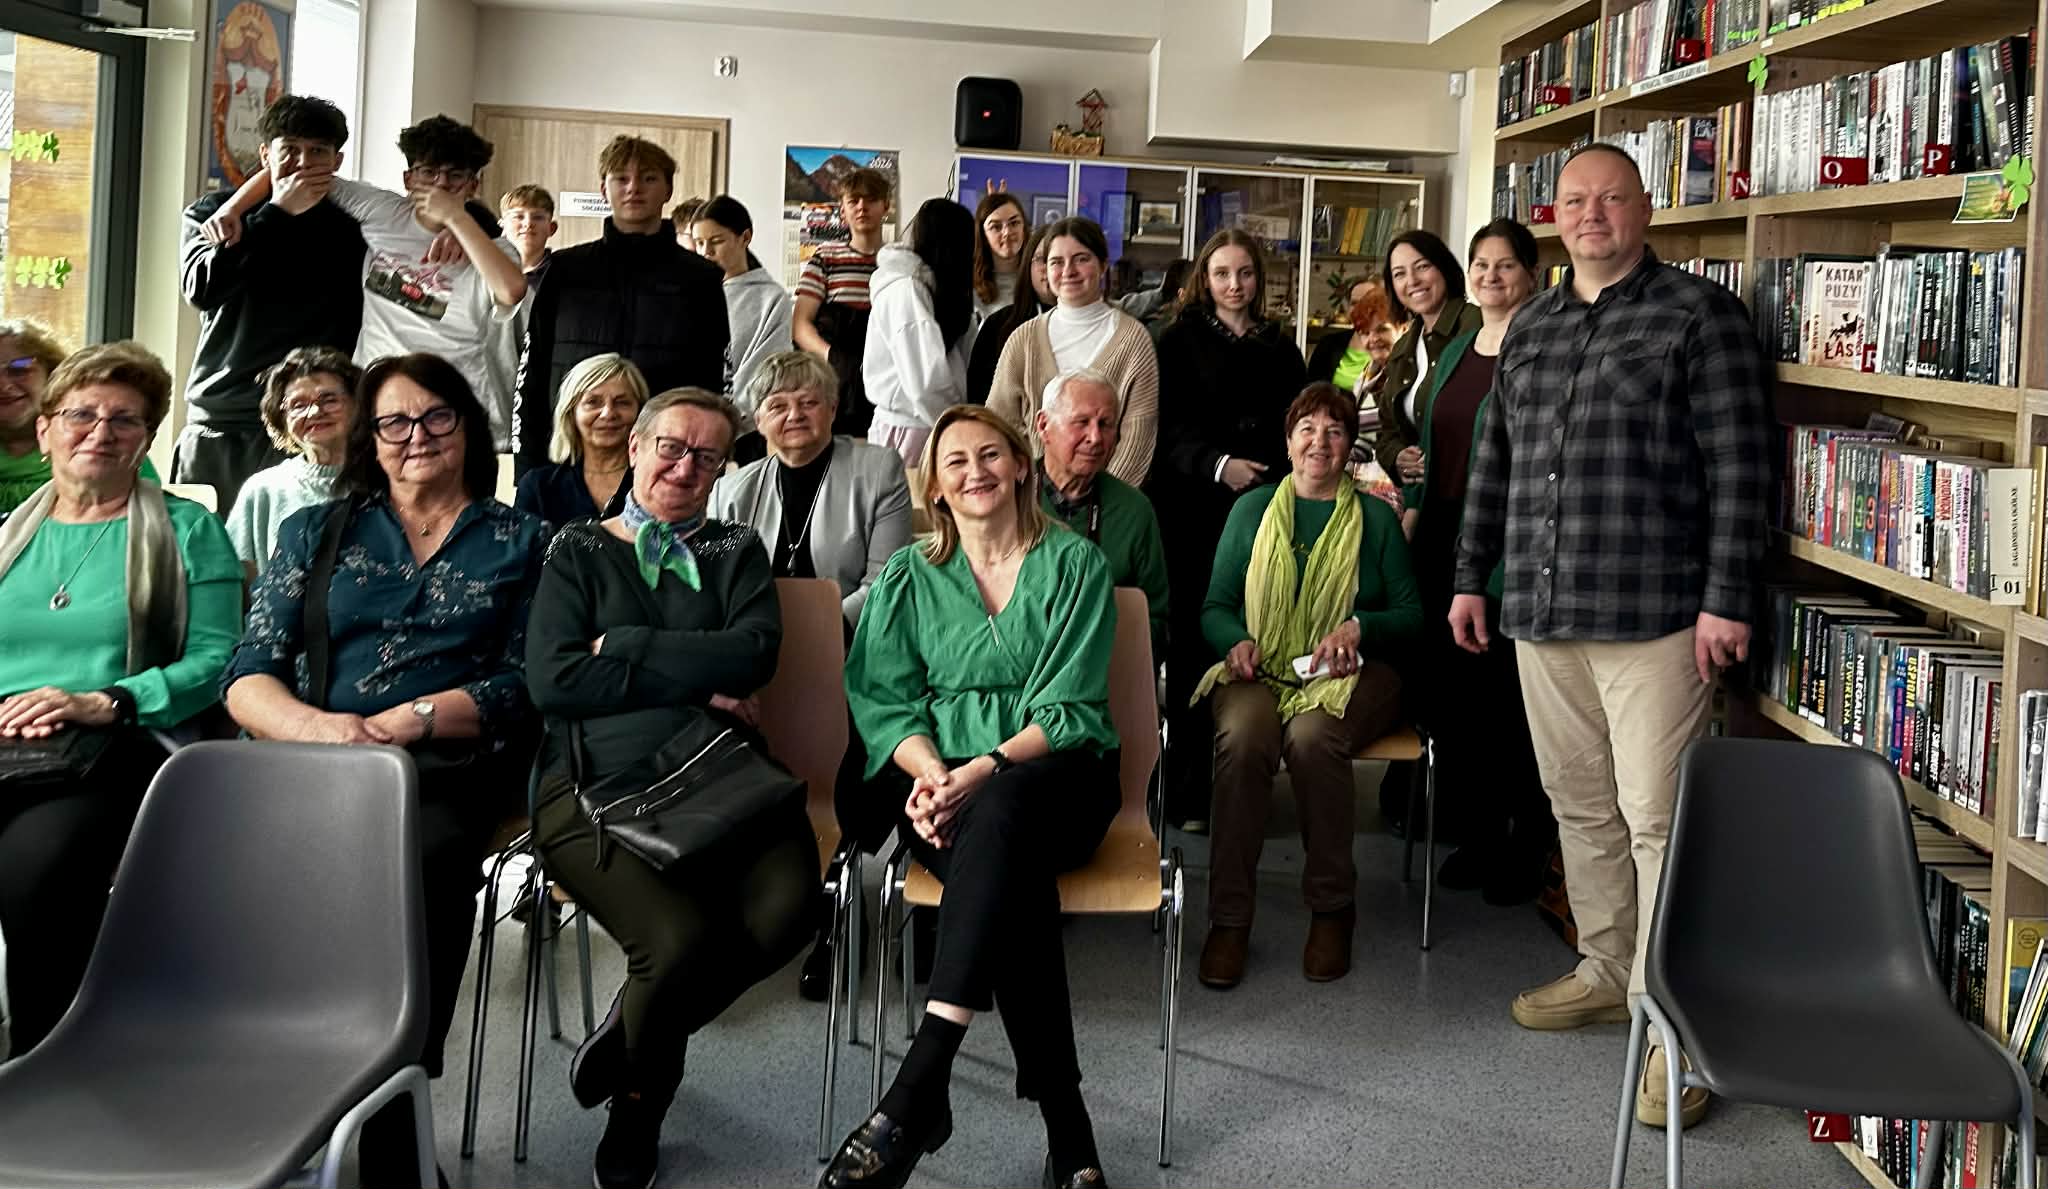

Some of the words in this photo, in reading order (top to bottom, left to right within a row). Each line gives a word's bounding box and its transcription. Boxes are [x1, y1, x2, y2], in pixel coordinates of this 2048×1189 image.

[1681, 44, 1693, 59] L
[1545, 89, 1555, 101] D
[1927, 151, 1943, 169] P
[1824, 161, 1843, 179] O
[1736, 176, 1749, 193] N
[1533, 207, 1544, 220] E
[2004, 581, 2020, 595] 01
[1854, 654, 1864, 731] NIELEGALNI
[1812, 1116, 1830, 1137] Z
